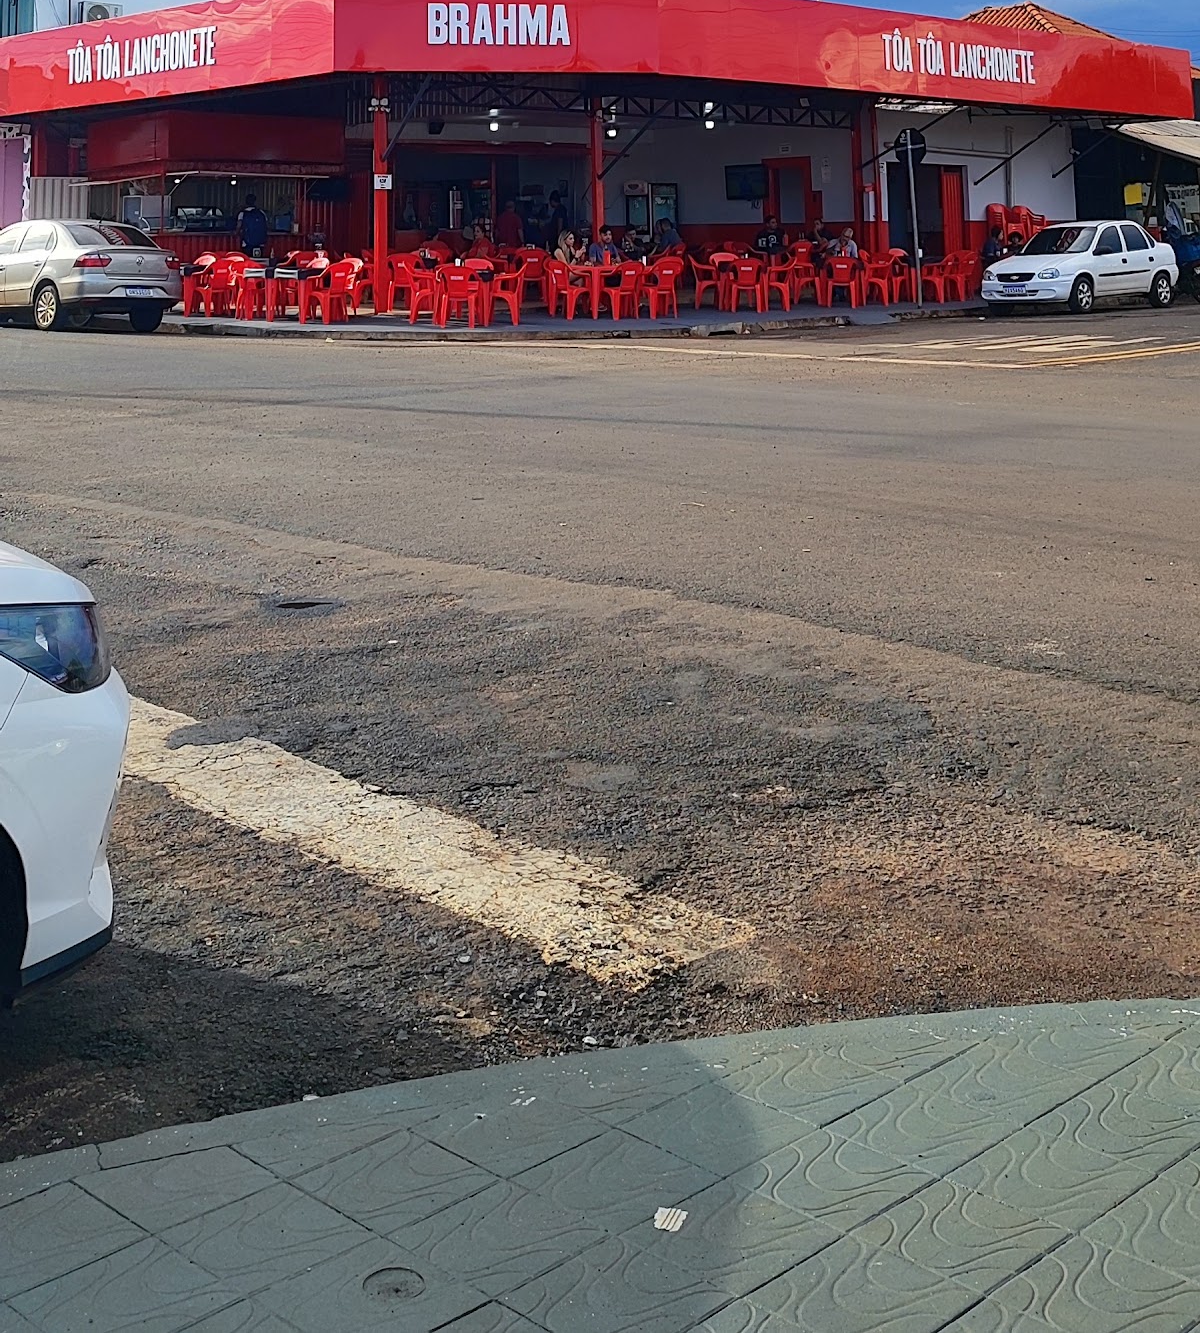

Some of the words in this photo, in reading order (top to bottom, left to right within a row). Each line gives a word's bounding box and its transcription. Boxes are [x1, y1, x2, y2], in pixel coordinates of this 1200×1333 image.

[427, 2, 571, 46] BRAHMA
[66, 39, 93, 85] TÔA
[95, 34, 121, 81] TÔA
[123, 25, 218, 77] LANCHONETE
[881, 27, 914, 73] TÔA
[916, 31, 945, 76] TÔA
[950, 41, 1036, 85] LANCHONETE
